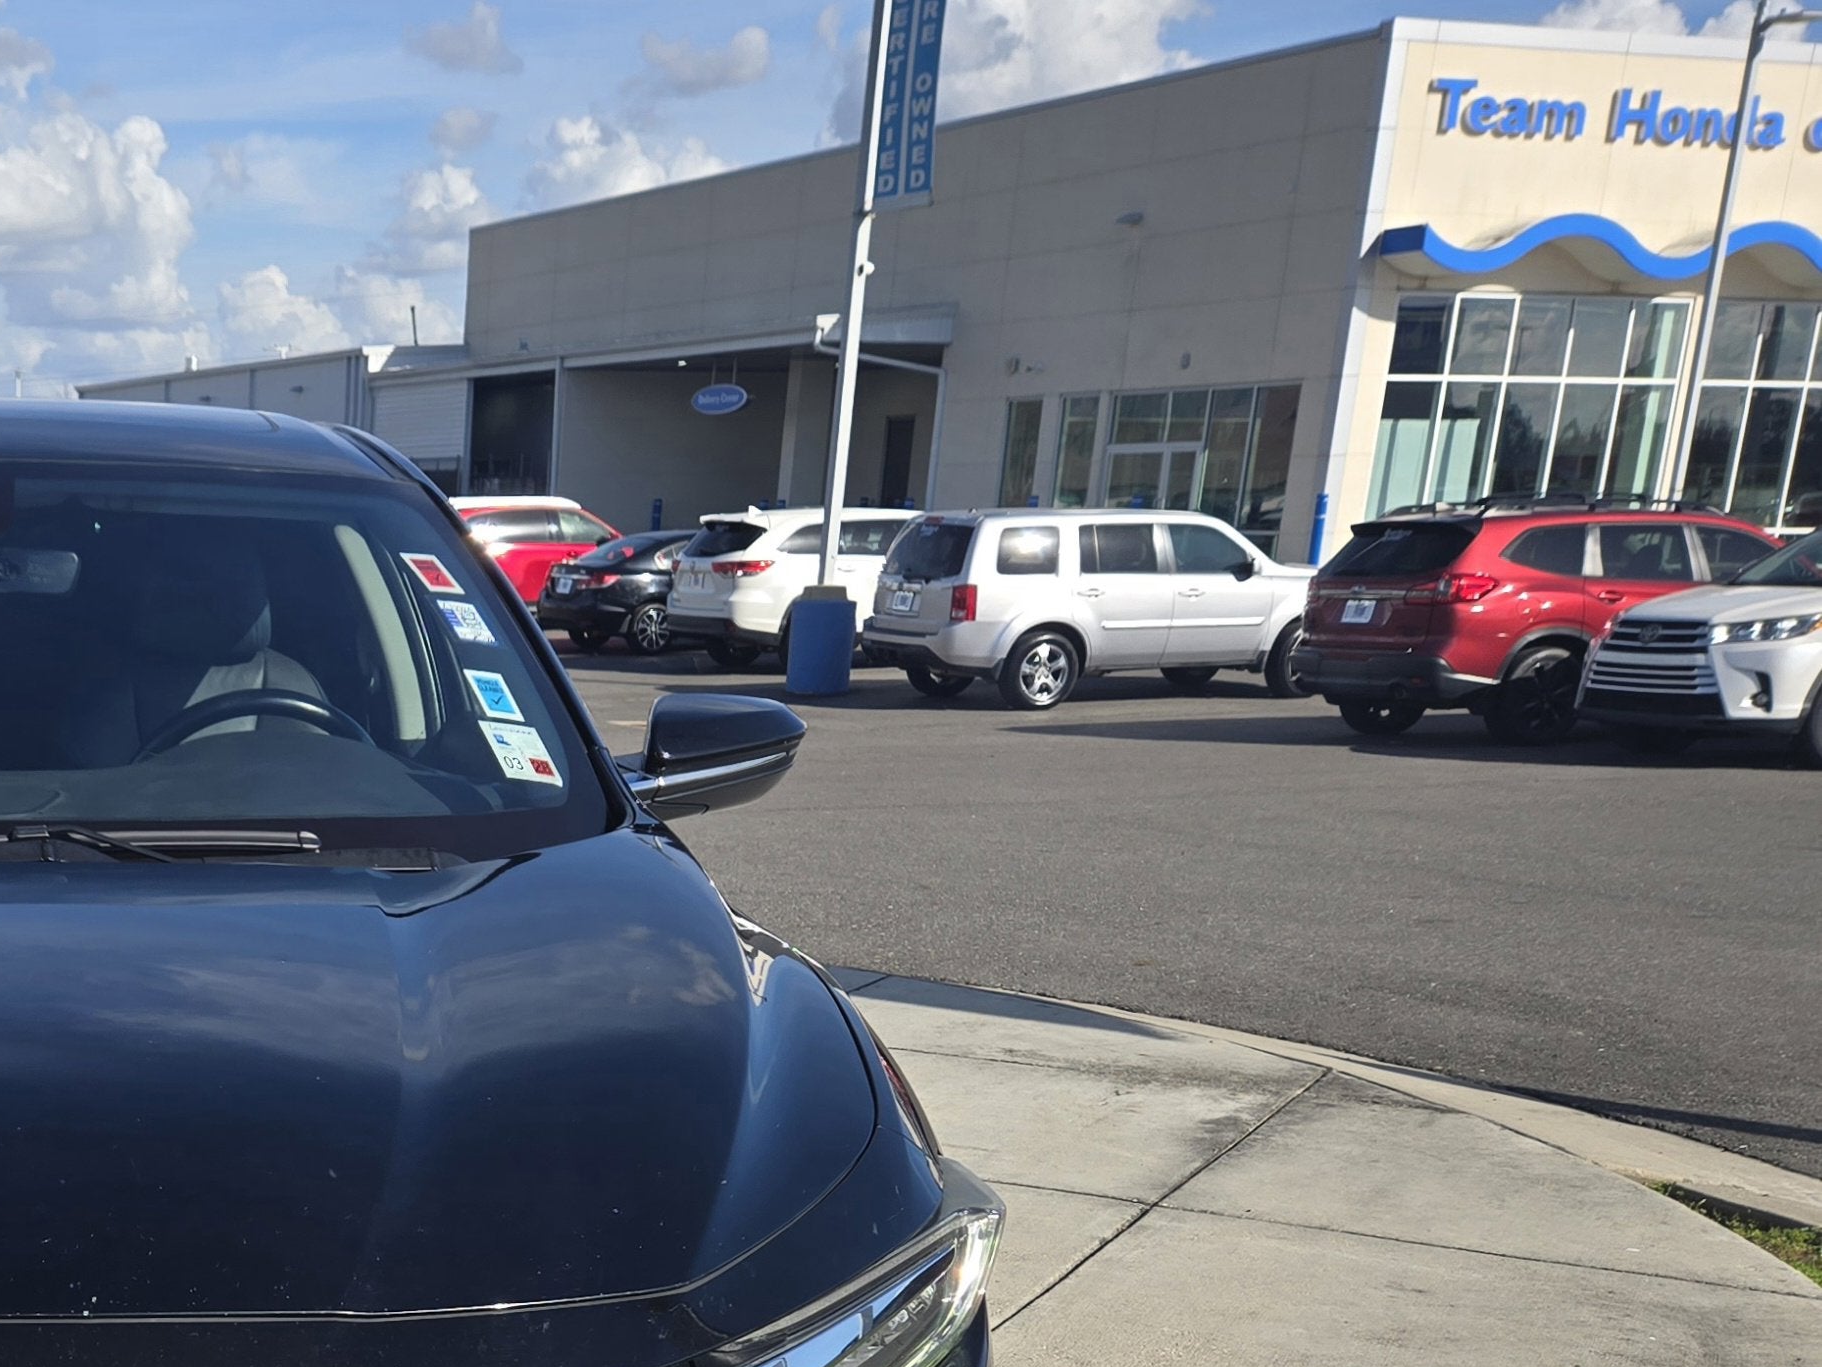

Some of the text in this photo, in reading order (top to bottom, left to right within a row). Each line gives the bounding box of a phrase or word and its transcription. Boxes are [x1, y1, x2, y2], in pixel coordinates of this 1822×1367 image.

[878, 0, 909, 193] ERTIFIED
[910, 72, 932, 188] OWNED
[1428, 77, 1587, 137] Team
[1608, 87, 1786, 149] Honda
[503, 755, 524, 771] 03
